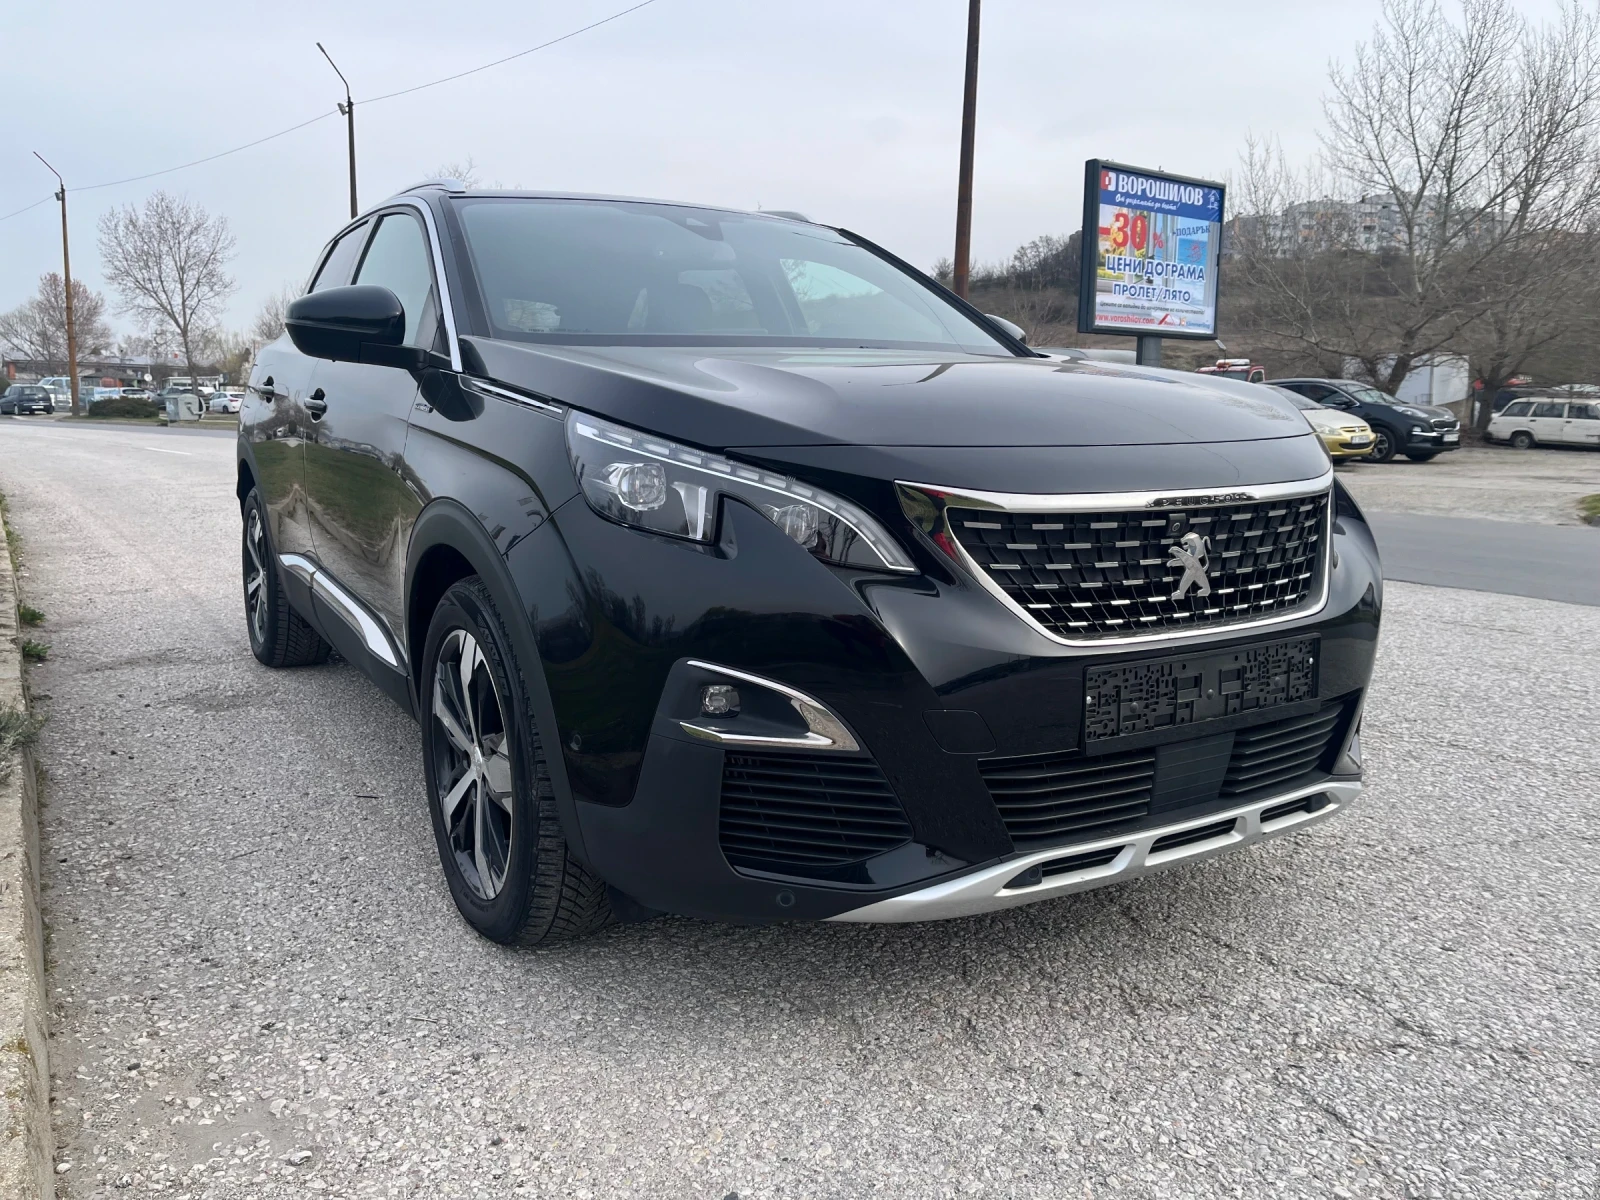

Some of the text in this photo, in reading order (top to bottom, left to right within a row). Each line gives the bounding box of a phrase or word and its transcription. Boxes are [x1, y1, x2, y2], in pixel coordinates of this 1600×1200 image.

[1118, 173, 1204, 206] ВОРОШИЛОВ
[1106, 255, 1205, 281] ЦЕНИ ДОГРАМА
[1113, 283, 1191, 302] ПРОЛЕТ/ЛЯТО
